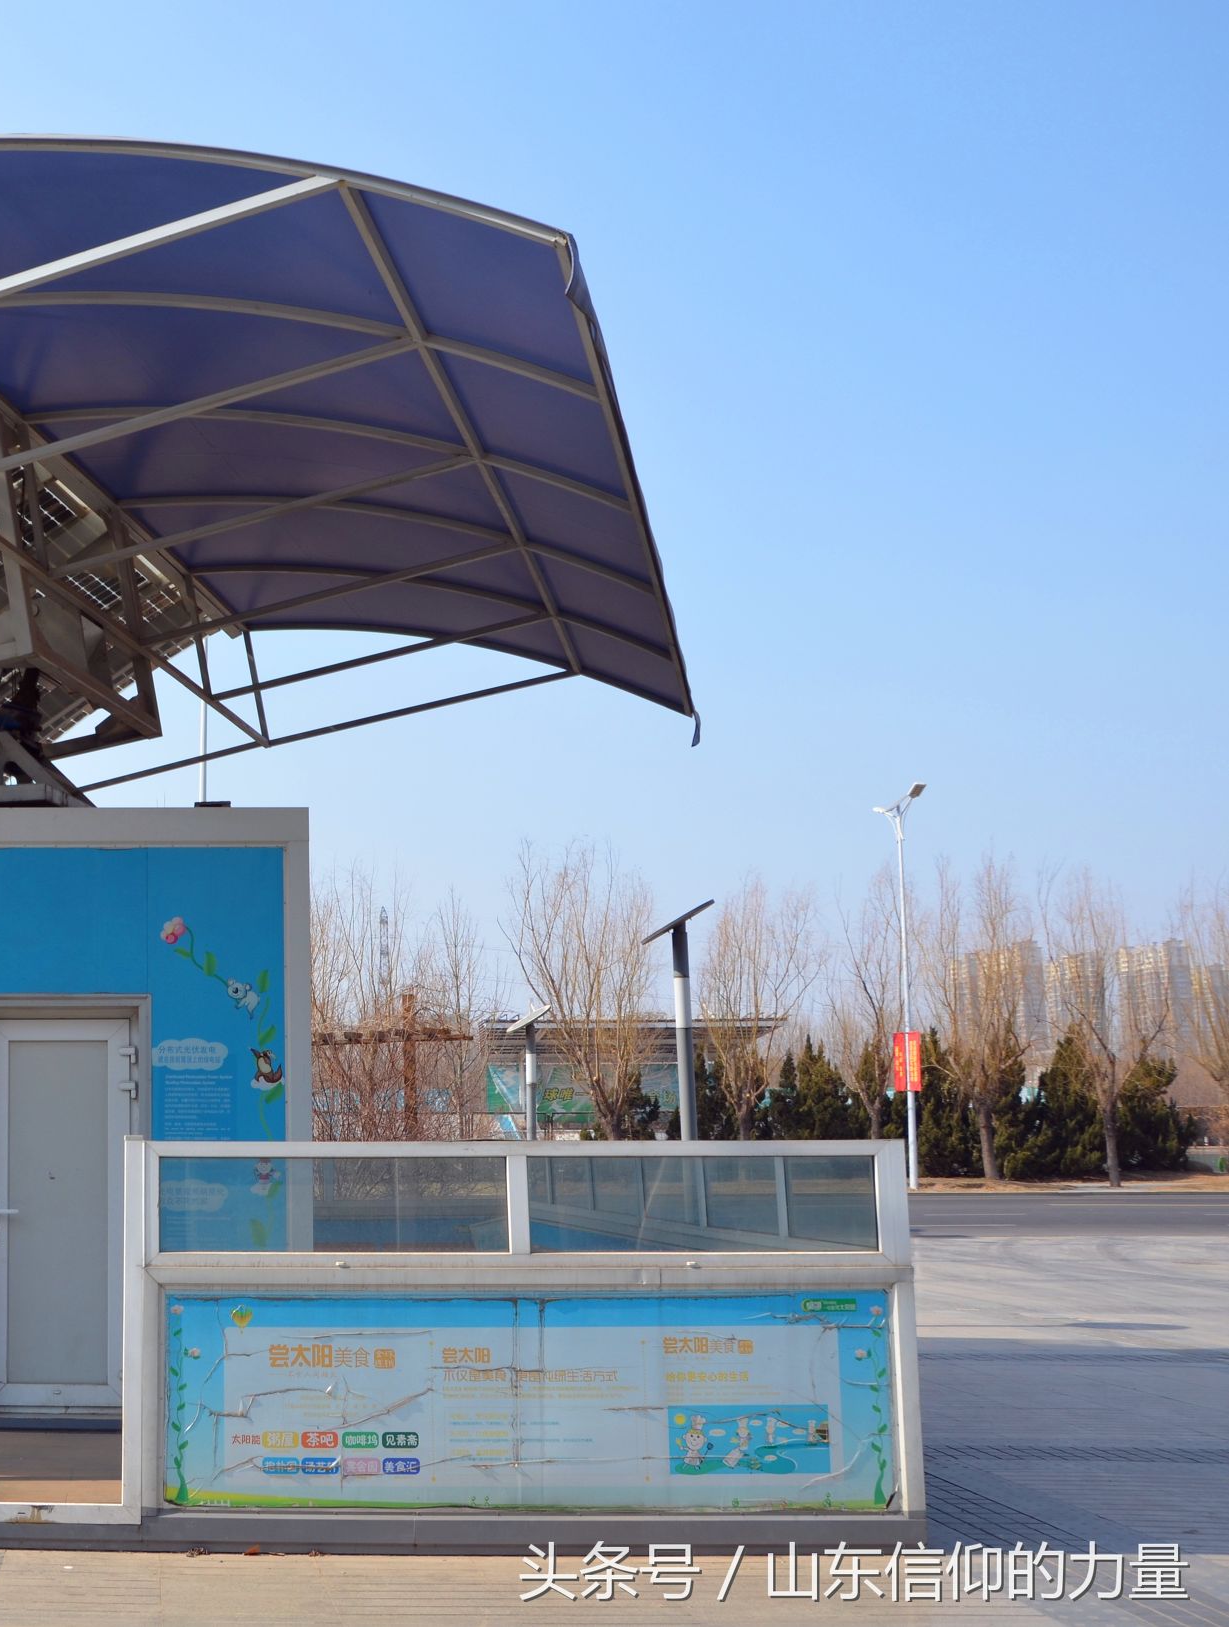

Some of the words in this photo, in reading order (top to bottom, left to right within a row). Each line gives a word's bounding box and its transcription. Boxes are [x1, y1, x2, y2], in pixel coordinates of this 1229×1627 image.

[268, 1344, 371, 1368] 尝太阳美食
[442, 1347, 491, 1364] 尝太阳
[306, 1432, 335, 1447] 茶吧
